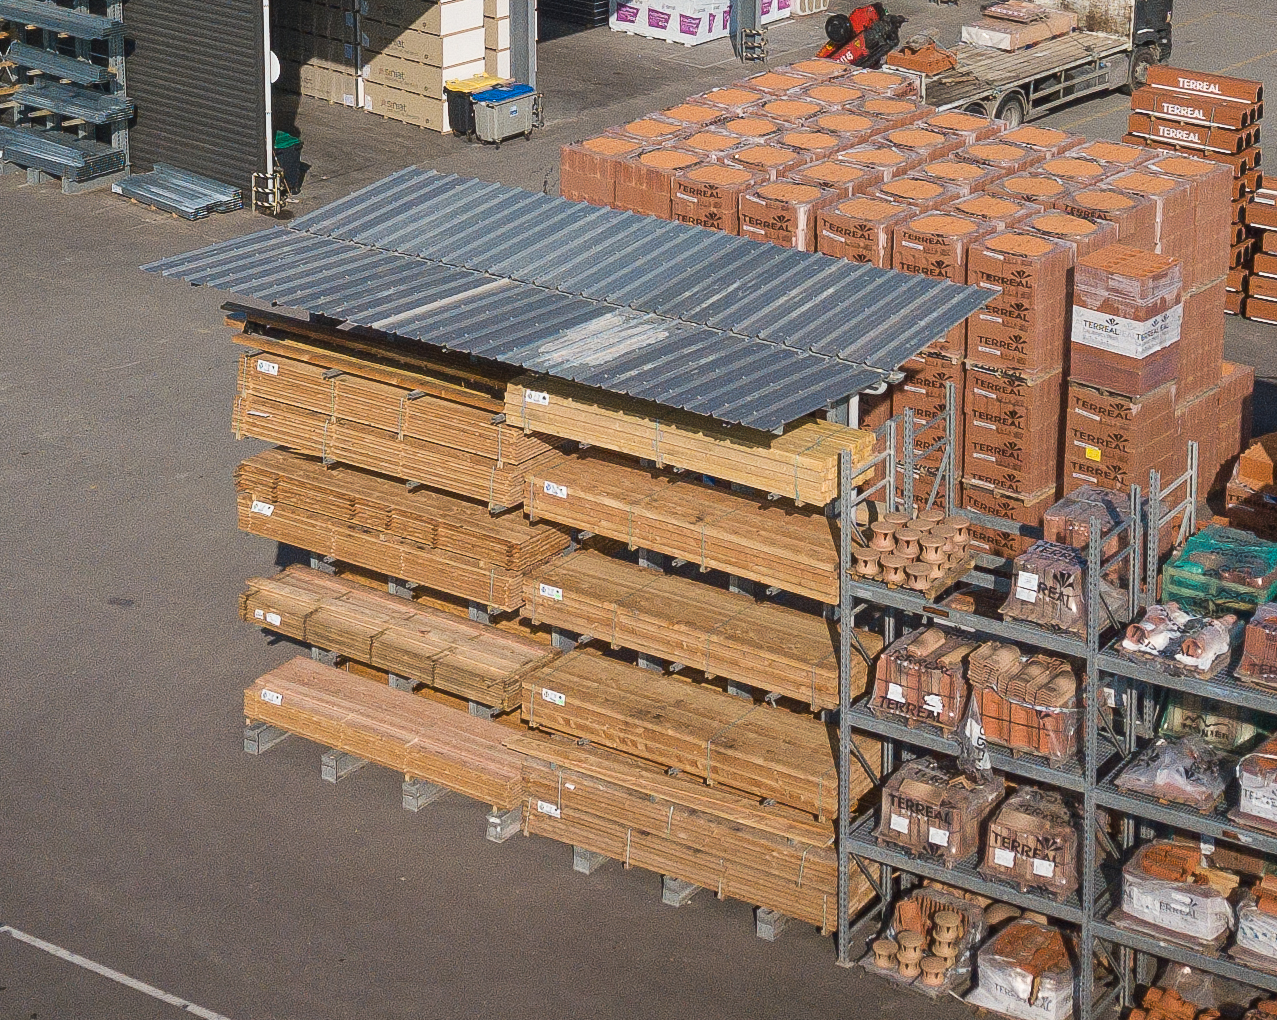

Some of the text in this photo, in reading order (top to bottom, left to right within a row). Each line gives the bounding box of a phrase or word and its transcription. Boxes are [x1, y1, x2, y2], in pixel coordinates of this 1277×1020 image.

[1178, 78, 1222, 94] TERREAL
[1162, 103, 1206, 119] TERREAL
[1159, 126, 1201, 143] TERREAL
[677, 182, 722, 199] TERREAL
[741, 213, 791, 233] TERREAL
[822, 218, 873, 241] TERREAL
[902, 231, 950, 246] TERREAL
[899, 261, 951, 279] TERREAL
[979, 270, 1032, 289] TERREAL
[985, 305, 1029, 322] ERREAL
[1083, 319, 1120, 336] TERREAL
[977, 335, 1028, 355] TERREAL
[974, 377, 1025, 397] TERREAL
[1073, 396, 1132, 421] TERREAL
[972, 409, 1024, 429] TERREAL
[1072, 428, 1130, 453] TERREAL
[972, 442, 1023, 462] TERREAL
[1070, 461, 1128, 486] TERREAL
[967, 495, 1017, 521] TERREAL
[1037, 581, 1073, 611] REAL
[888, 793, 952, 826] TERREAL
